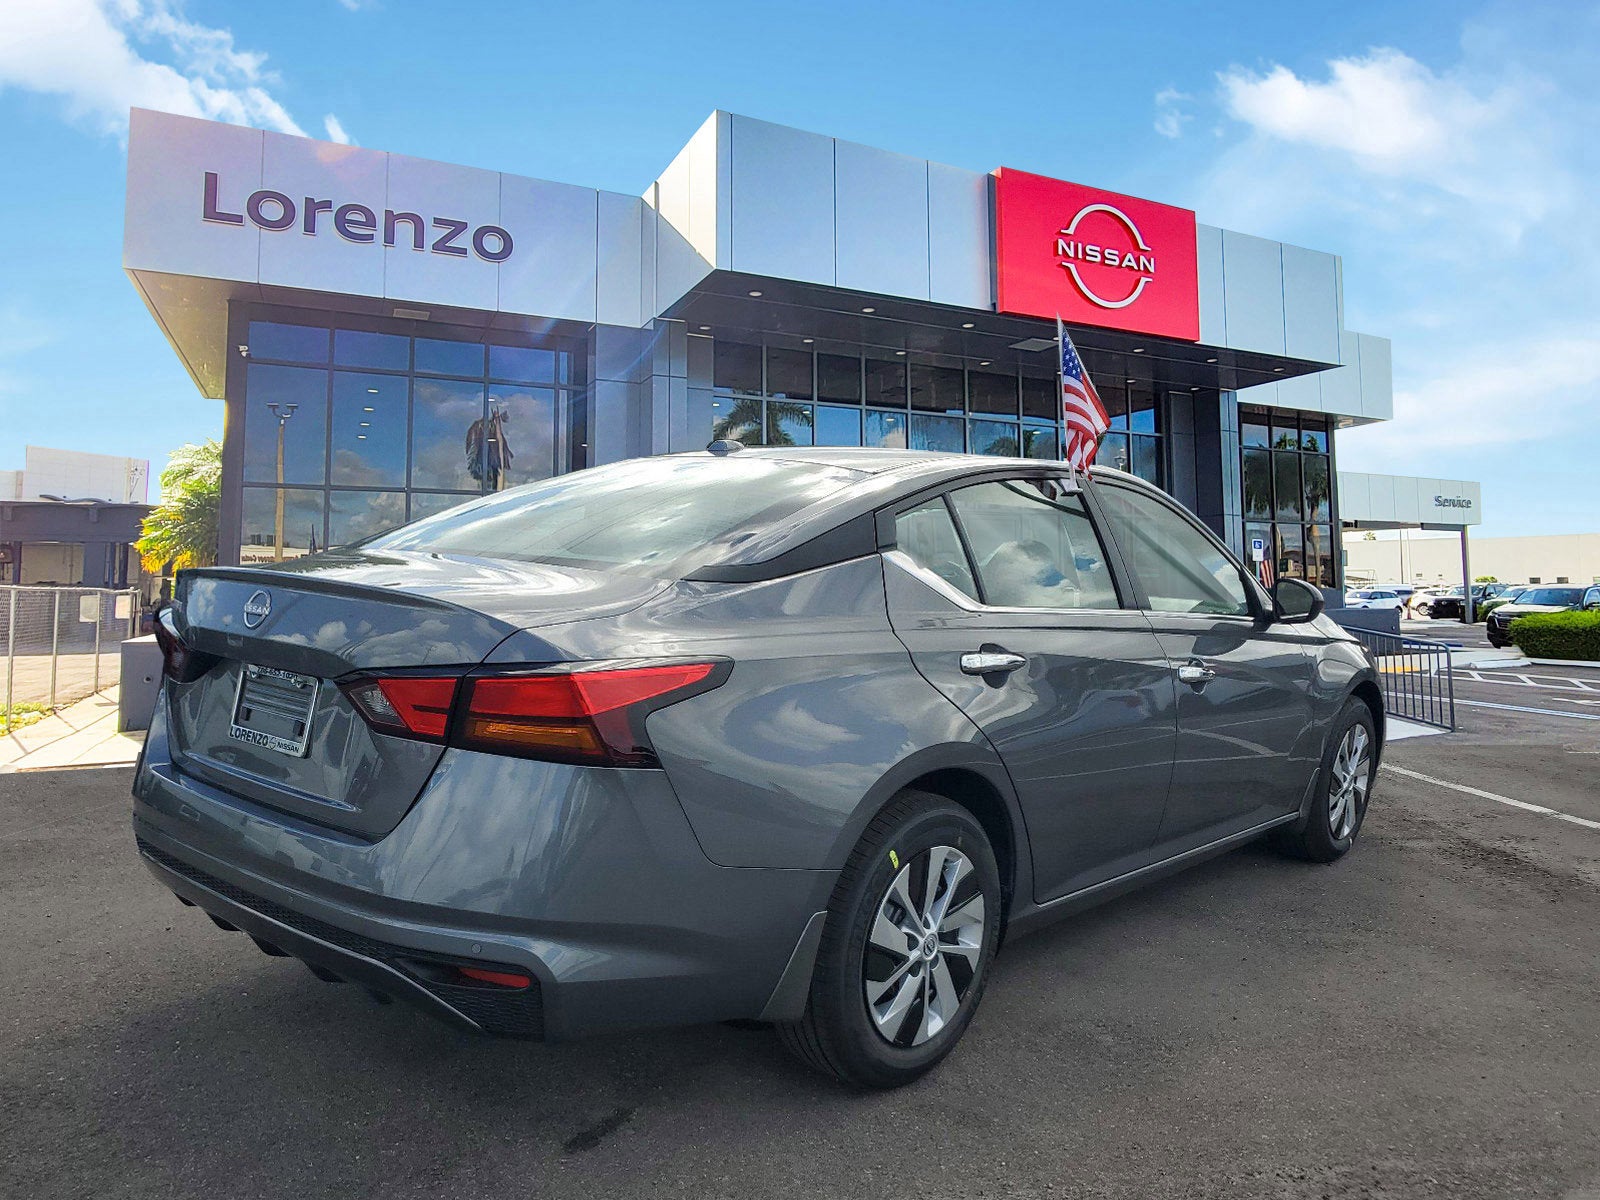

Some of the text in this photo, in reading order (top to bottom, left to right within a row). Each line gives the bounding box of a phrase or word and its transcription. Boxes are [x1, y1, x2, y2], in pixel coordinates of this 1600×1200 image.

[202, 171, 514, 262] Lorenzo
[1057, 238, 1155, 273] NISSAN
[1434, 495, 1472, 508] Service
[229, 726, 300, 754] LORENZO NISSAN
